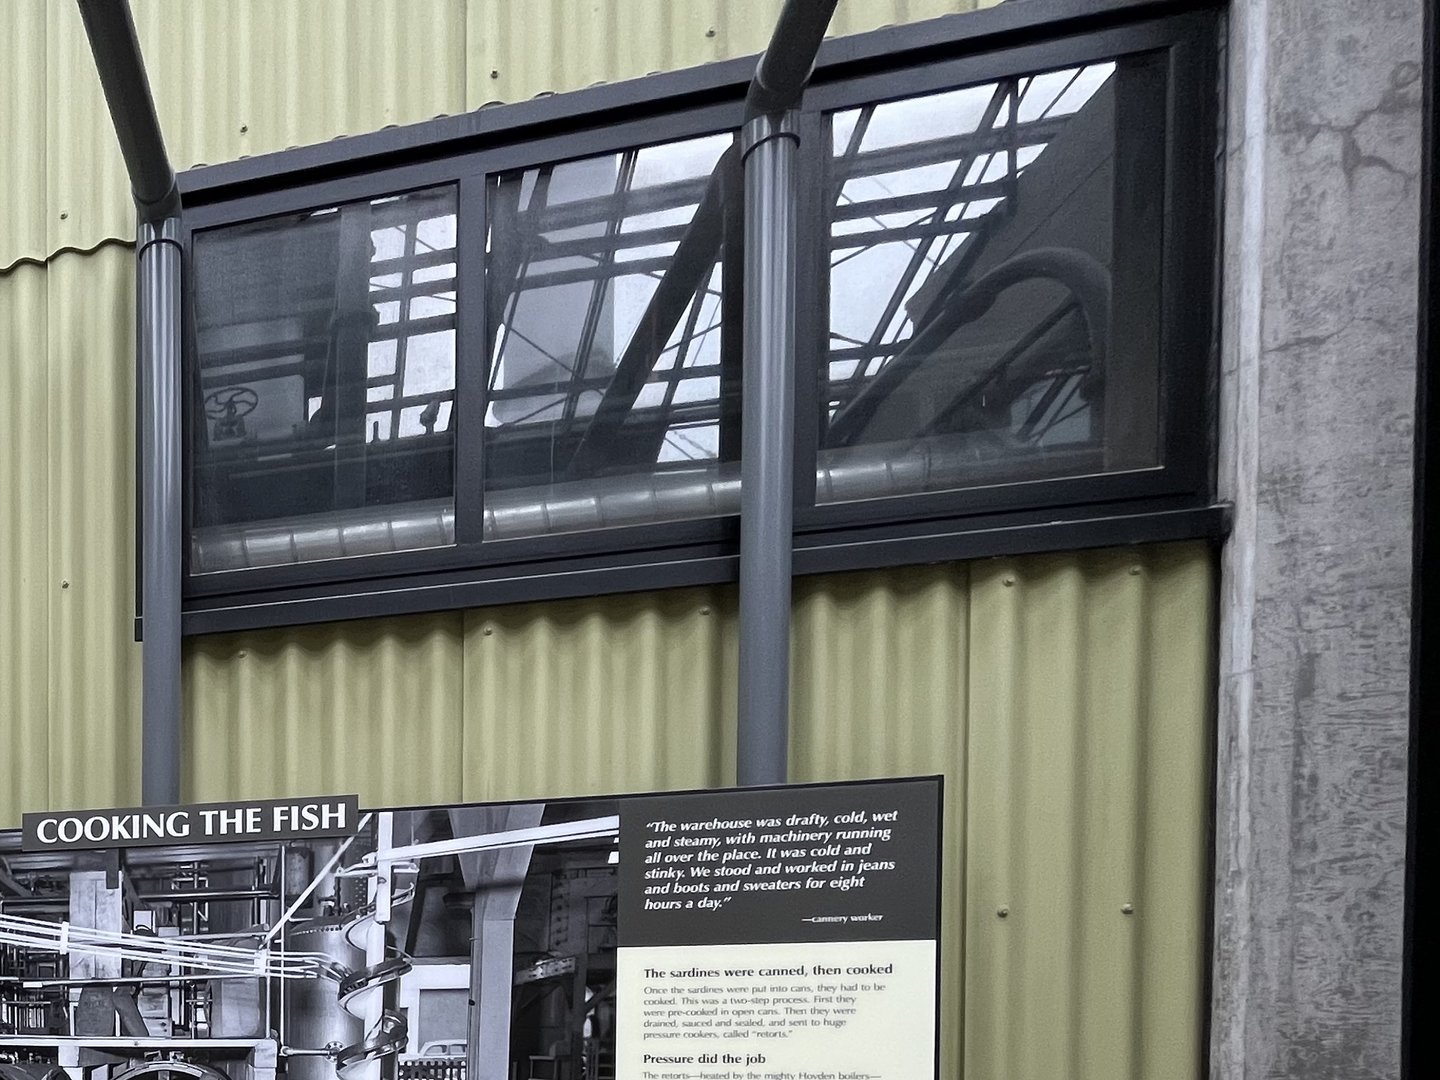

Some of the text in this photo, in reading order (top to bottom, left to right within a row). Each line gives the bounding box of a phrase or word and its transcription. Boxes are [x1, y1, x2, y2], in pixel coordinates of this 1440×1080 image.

[36, 803, 347, 844] COOKING THE FISH
[646, 810, 898, 833] “The warehouse was drafty, cold, wet
[645, 826, 891, 852] and steamy, with machinery running
[644, 842, 872, 865] all over the place. It was cold and
[644, 858, 895, 883] stinky. We stood and worked in jeans
[644, 875, 865, 894] and boots and sweaters for eight
[644, 895, 731, 913] hours a day.”
[801, 913, 883, 926] —cannery worker
[644, 964, 892, 978] The sardines were canned, then cooked
[643, 985, 668, 994] Once
[670, 985, 685, 994] the
[687, 985, 724, 994] sardines
[751, 985, 766, 996] put
[769, 984, 788, 993] into
[790, 986, 814, 994] cans,
[817, 983, 837, 995] they
[840, 983, 858, 992] had
[861, 983, 871, 991] to
[873, 982, 886, 991] be
[643, 997, 677, 1005] cooked.
[681, 996, 699, 1005] This
[730, 996, 770, 1008] two-step
[772, 998, 809, 1007] process.
[813, 995, 833, 1004] First
[835, 995, 856, 1007] they
[667, 1007, 718, 1019] pre-cooked
[720, 1007, 729, 1016] in
[731, 1009, 755, 1019] open
[784, 1007, 807, 1015] Then
[810, 1006, 830, 1018] they
[643, 1018, 847, 1030] drained, sauced and sealed, and sent to huge
[643, 1029, 793, 1042] pressure cookers, called “retorts.”
[643, 1052, 766, 1067] Pressure did the job
